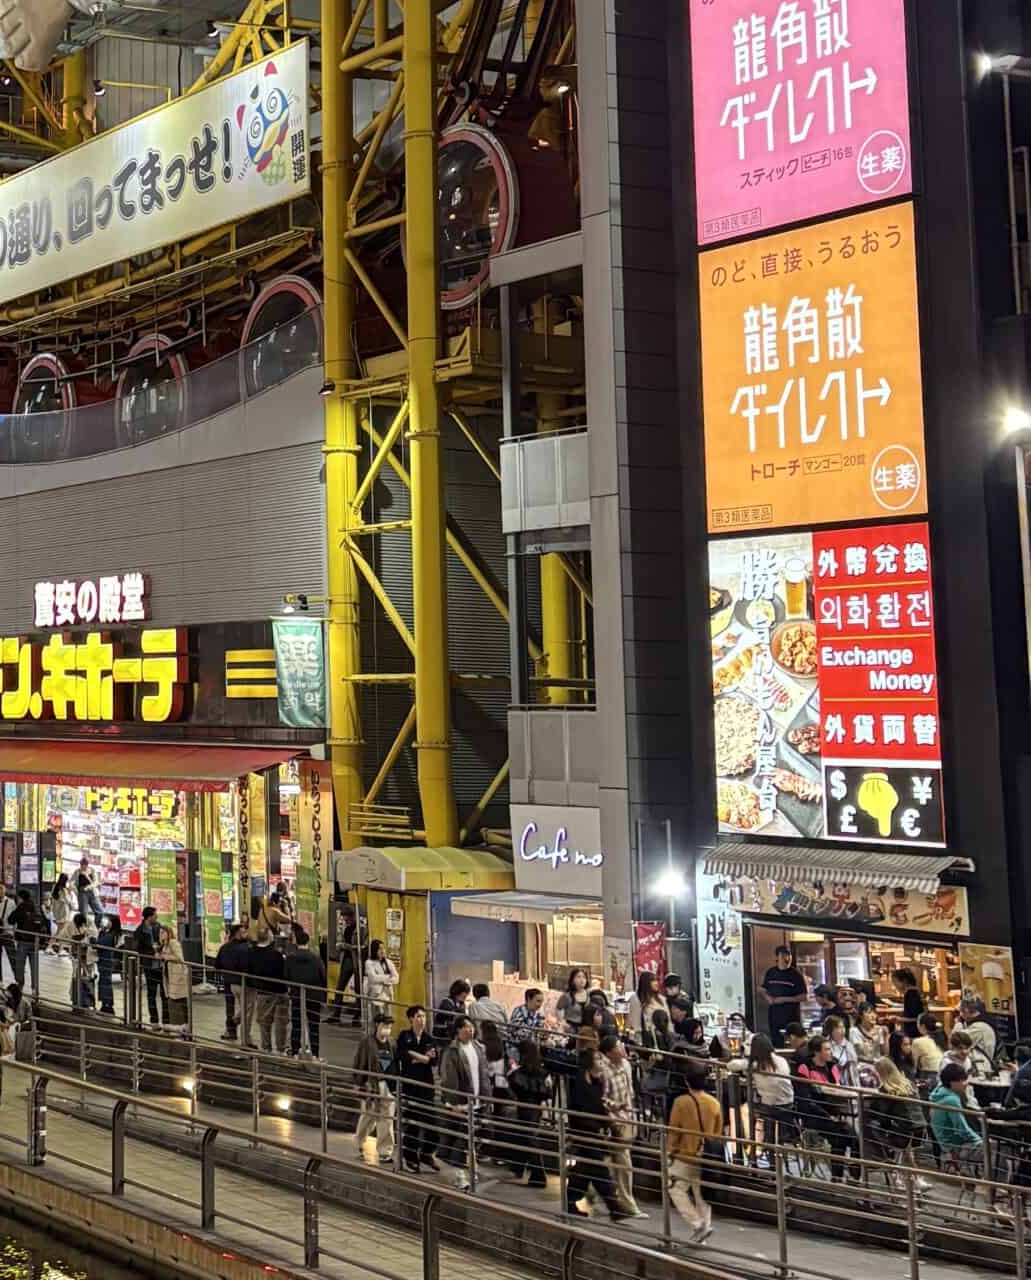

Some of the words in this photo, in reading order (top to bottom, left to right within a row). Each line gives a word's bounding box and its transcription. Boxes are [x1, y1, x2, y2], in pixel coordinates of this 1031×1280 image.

[718, 66, 879, 161] ダイレクト
[860, 144, 903, 180] 生薬
[710, 224, 904, 289] のど、直接、うるおう
[742, 282, 865, 376] 龍角散
[729, 366, 893, 453] ダイレクト
[750, 458, 801, 481] トローチ
[874, 463, 918, 492] 生薬
[34, 571, 147, 629] 驚安の殿堂
[819, 589, 933, 631] 외화환전
[821, 646, 914, 668] Exchange
[869, 670, 935, 694] Money
[824, 713, 938, 747] 外貨両替
[520, 821, 570, 870] Cafe
